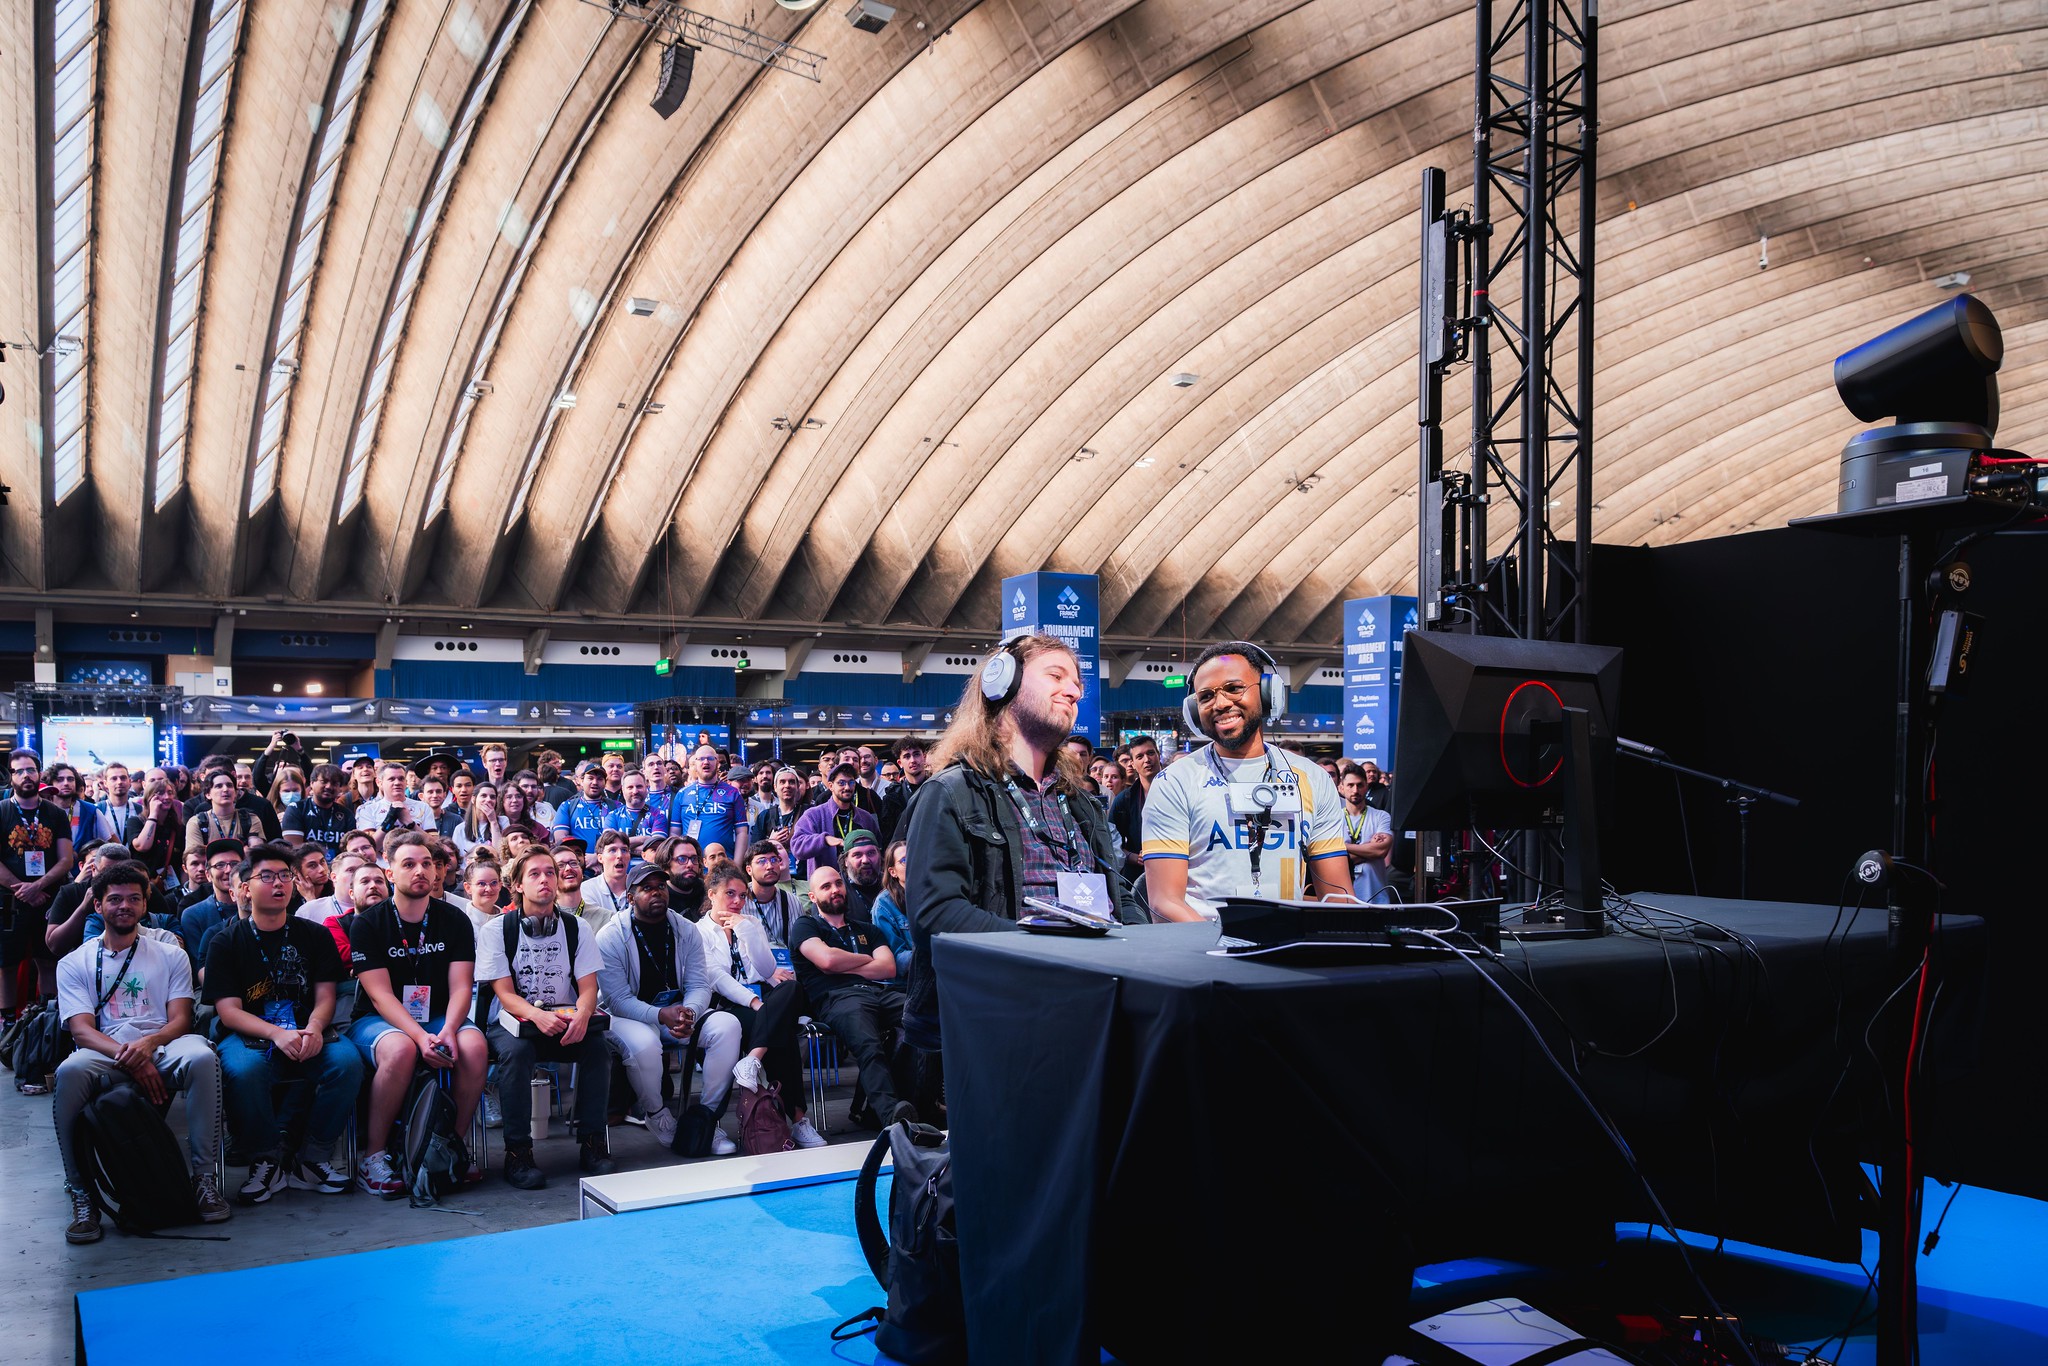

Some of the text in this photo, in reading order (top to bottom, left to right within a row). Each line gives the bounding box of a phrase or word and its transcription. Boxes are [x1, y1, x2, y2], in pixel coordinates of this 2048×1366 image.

[1012, 606, 1027, 614] EVO
[1043, 624, 1095, 638] TOURNAMENT
[1357, 624, 1376, 632] EVO
[1346, 641, 1386, 656] TOURNAMENT
[1358, 653, 1374, 665] AREA
[1858, 862, 1882, 879] K&M
